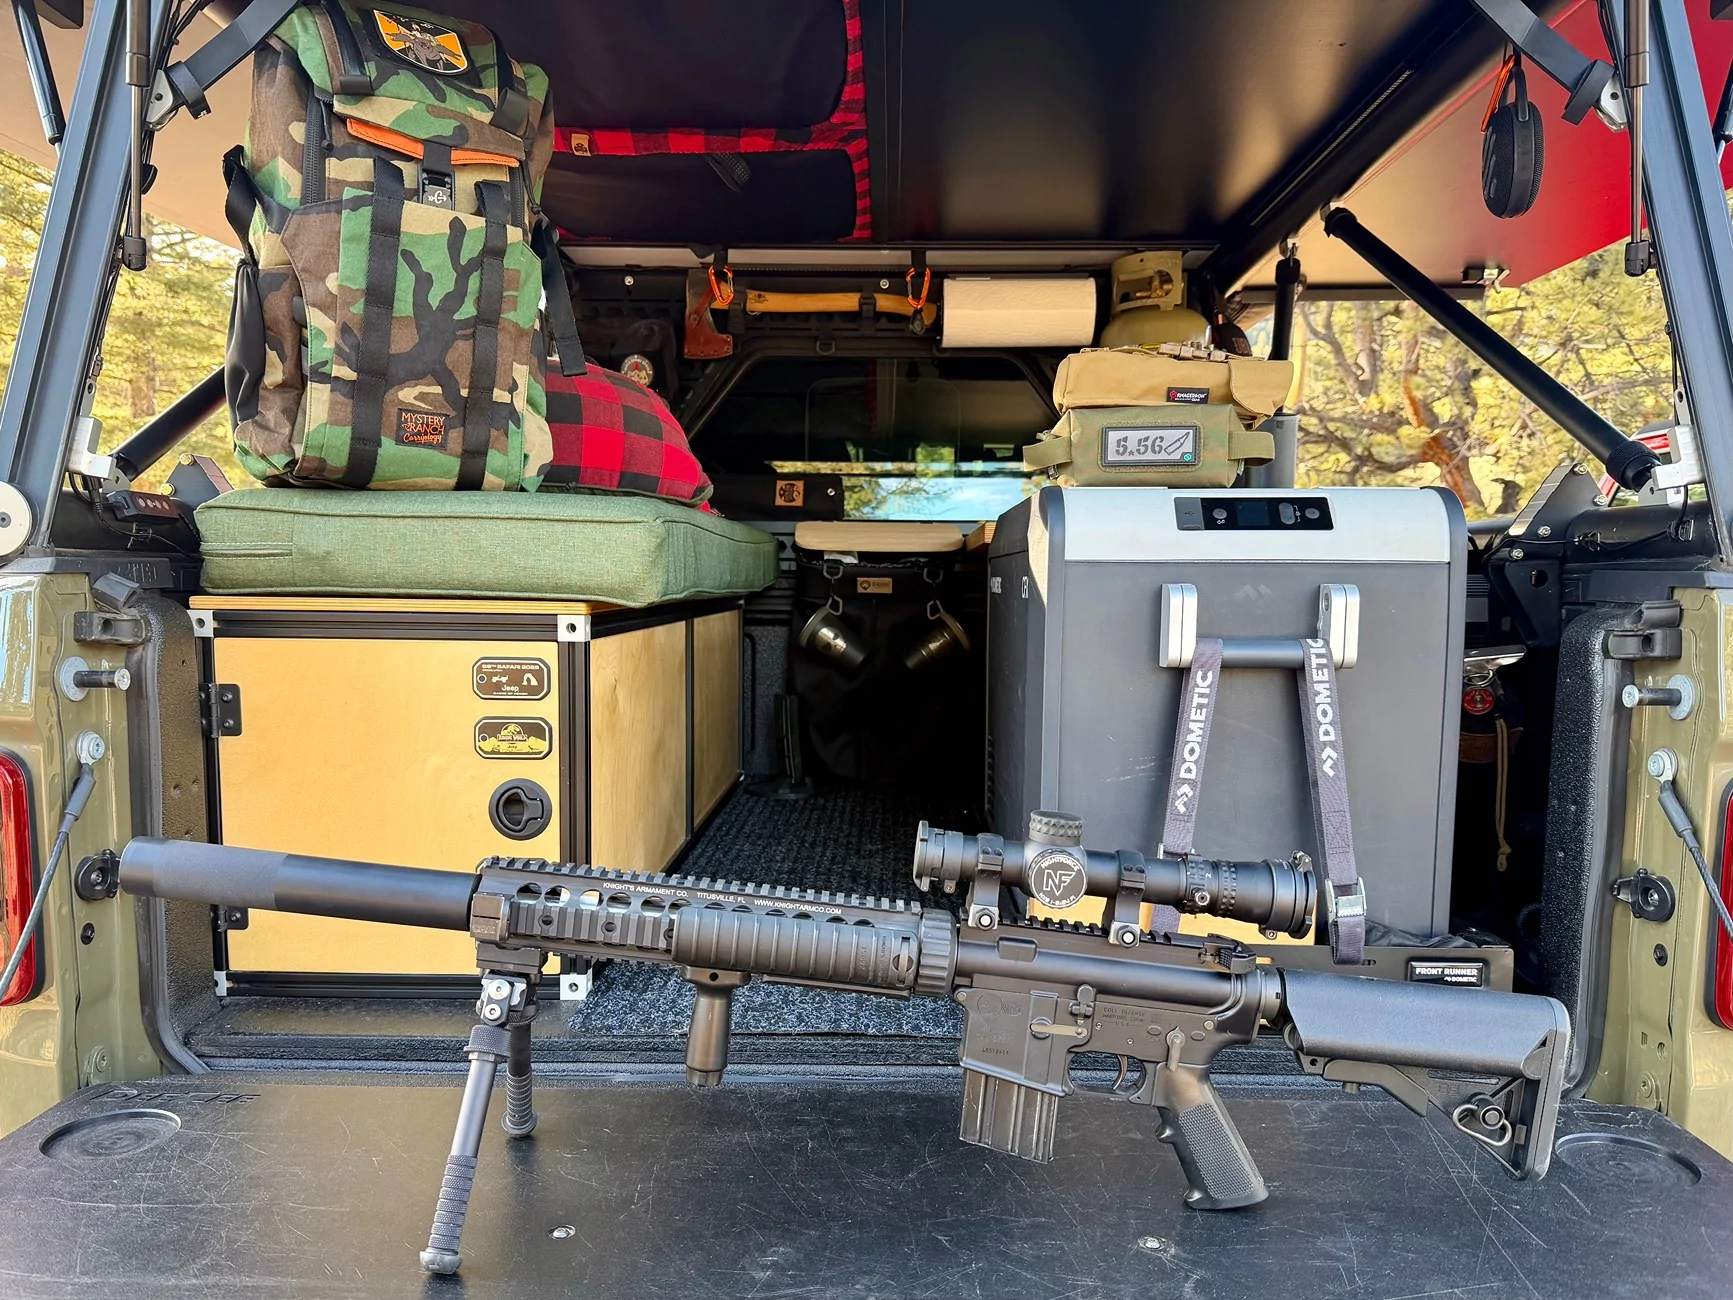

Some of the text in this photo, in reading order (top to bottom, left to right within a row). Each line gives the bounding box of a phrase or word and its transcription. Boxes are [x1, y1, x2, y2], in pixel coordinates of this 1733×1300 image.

[401, 412, 445, 426] MYSTERY
[409, 422, 445, 435] RANCH
[501, 684, 520, 693] Jeep
[1306, 639, 1336, 742] DOMETIC
[1179, 670, 1213, 780] DOMETIC
[1040, 856, 1080, 872] NIGHTFORCE
[1043, 869, 1076, 896] NF
[603, 881, 842, 915] KNIGHT'S ARMAMENT CO. TITUSVILLE, FL WWW.KNIGHTARMCO.COM
[1443, 968, 1478, 976] RUNNER
